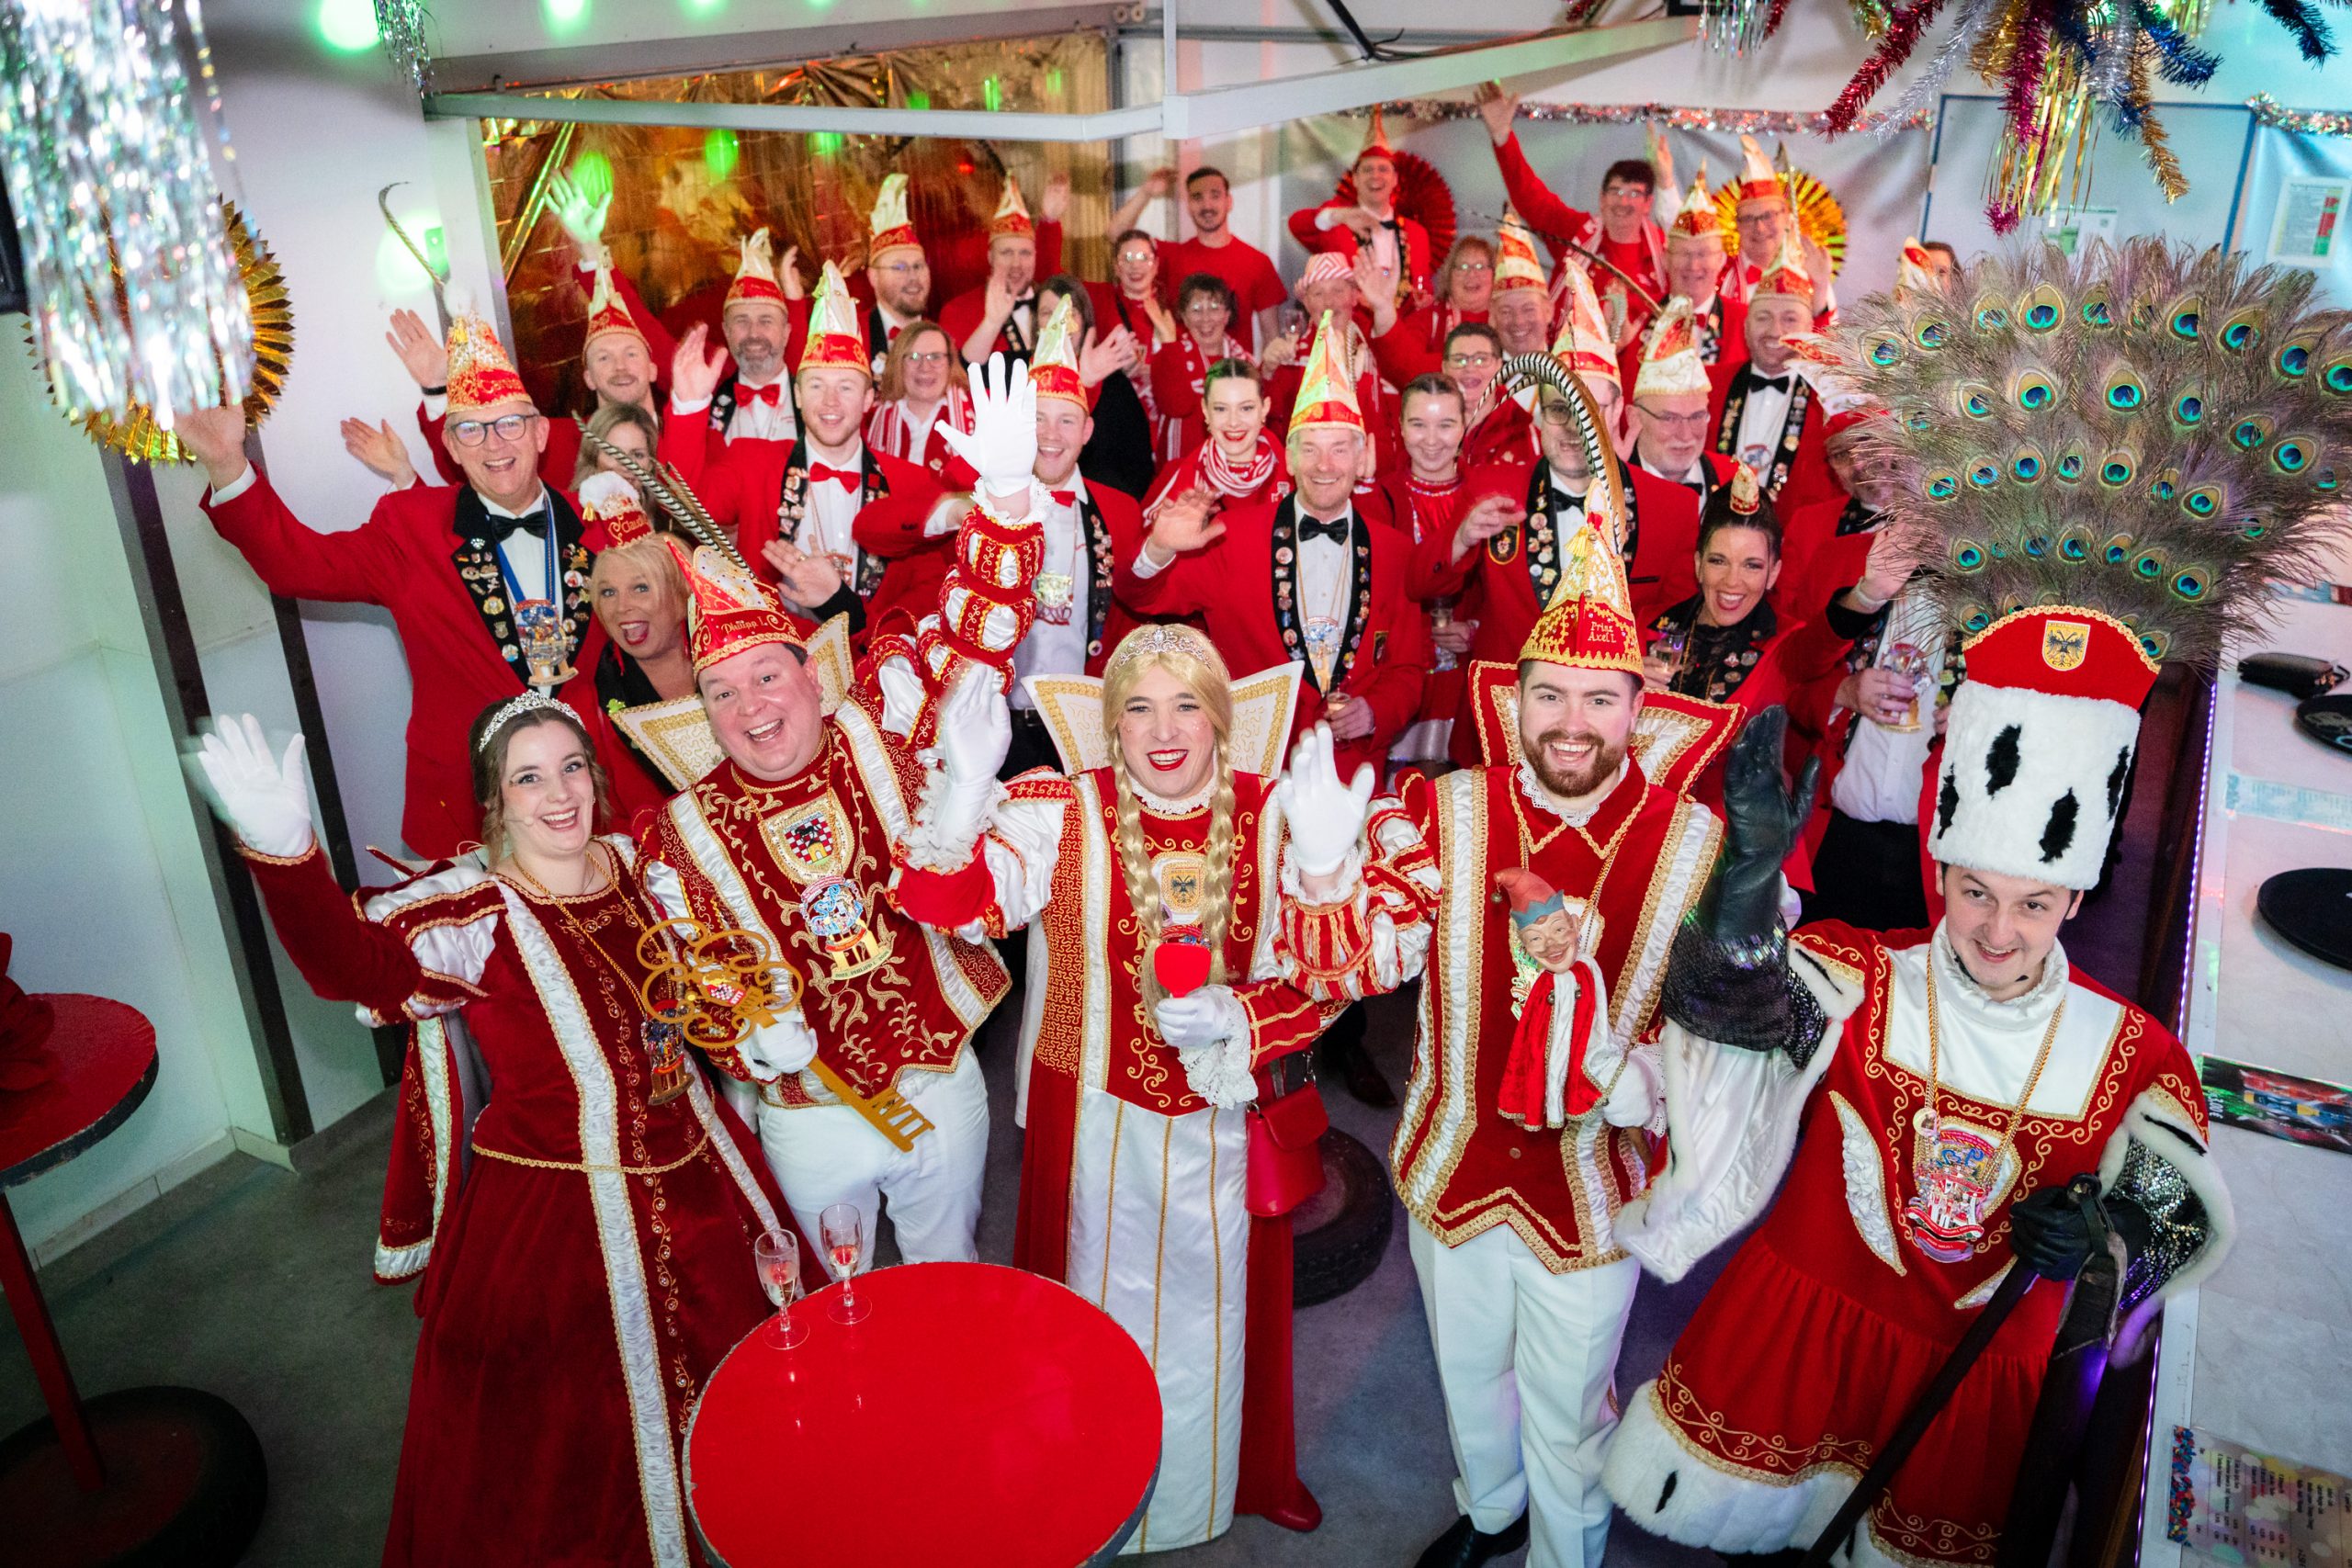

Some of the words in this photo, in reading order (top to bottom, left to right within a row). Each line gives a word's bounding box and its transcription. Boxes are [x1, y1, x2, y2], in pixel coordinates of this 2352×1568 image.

[720, 619, 758, 636] Philipp
[1590, 621, 1613, 632] Prinz
[1587, 630, 1611, 643] Axel
